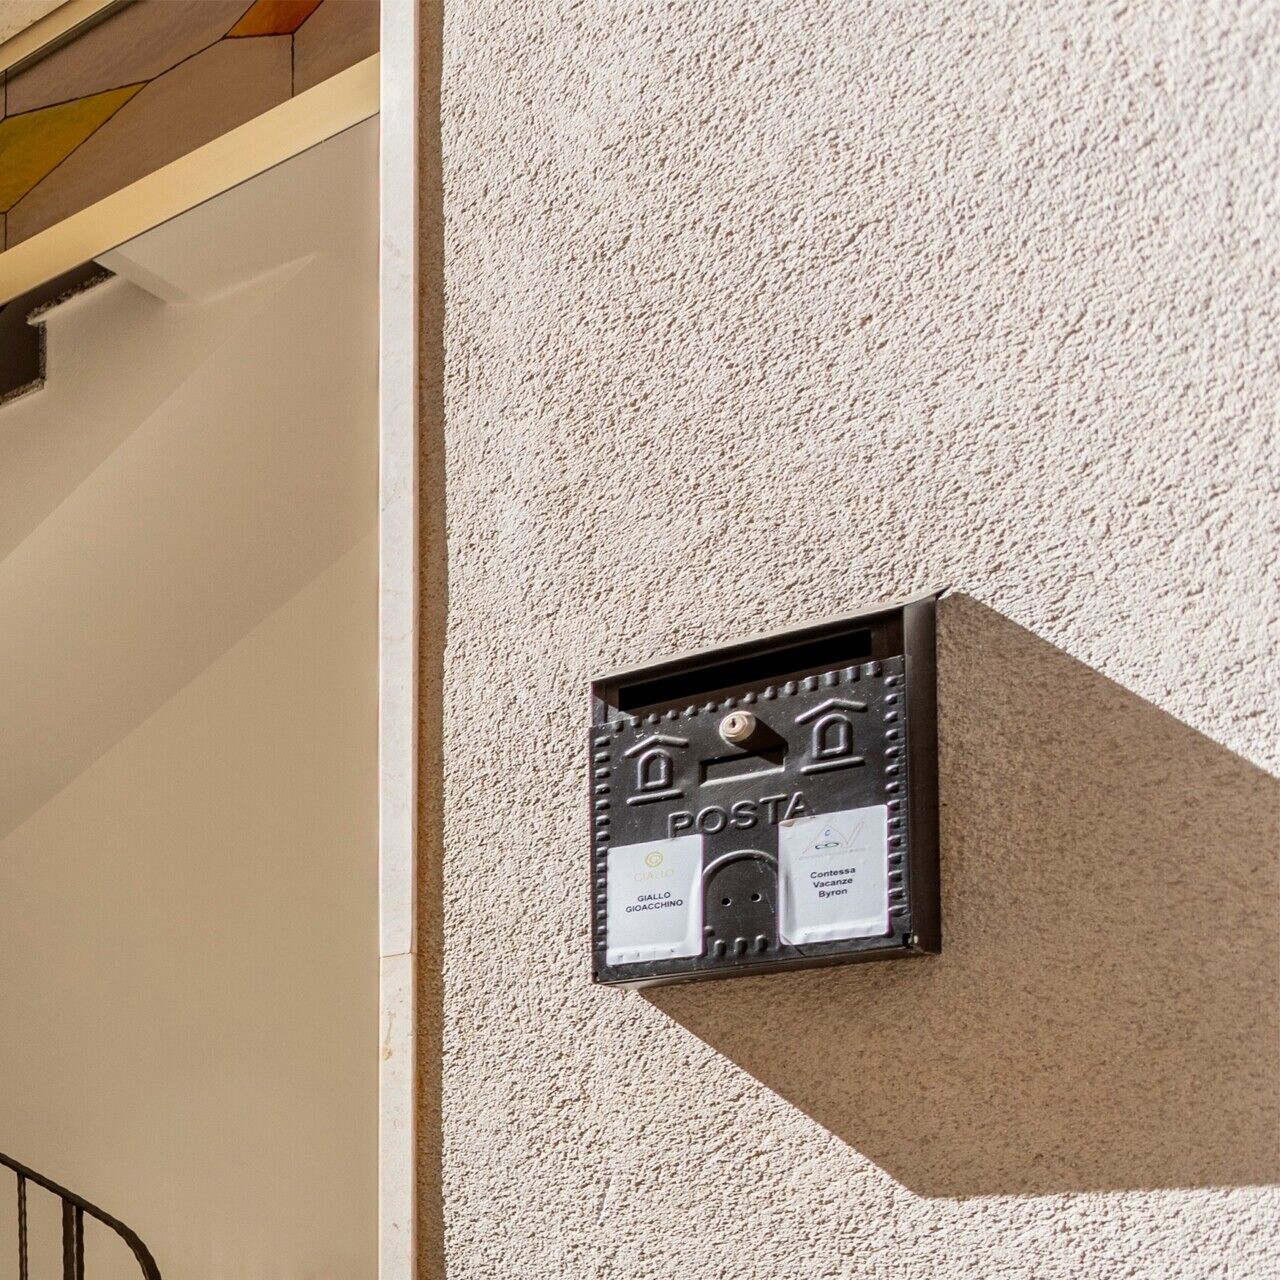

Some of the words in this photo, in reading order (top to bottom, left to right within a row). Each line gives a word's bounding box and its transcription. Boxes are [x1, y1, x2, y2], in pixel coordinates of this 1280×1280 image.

[668, 791, 812, 837] POSTA
[810, 867, 856, 879] Contessa
[812, 878, 853, 888] Vacanze
[637, 892, 671, 902] GIALLO
[818, 888, 848, 898] Byron
[625, 899, 683, 913] GIOACCHINO
